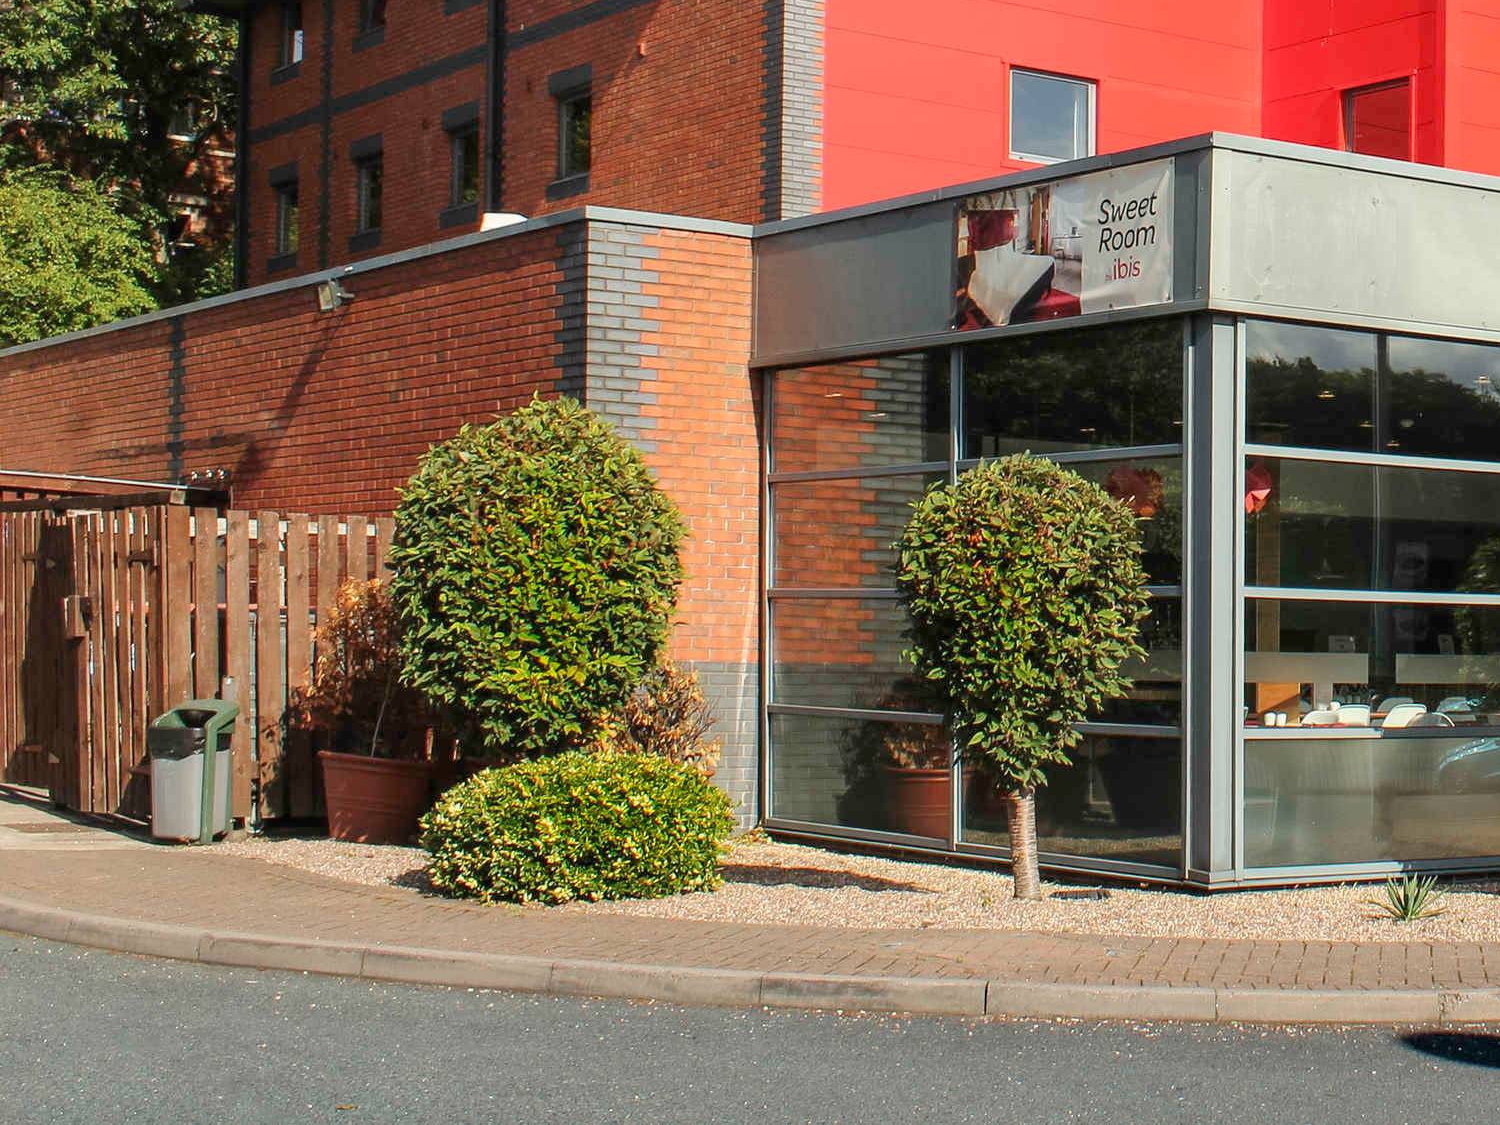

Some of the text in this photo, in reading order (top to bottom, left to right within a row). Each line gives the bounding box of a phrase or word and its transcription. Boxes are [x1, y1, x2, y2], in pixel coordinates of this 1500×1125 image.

[1097, 191, 1158, 225] Sweet
[1098, 225, 1156, 253] Room
[1113, 255, 1141, 280] ibis
